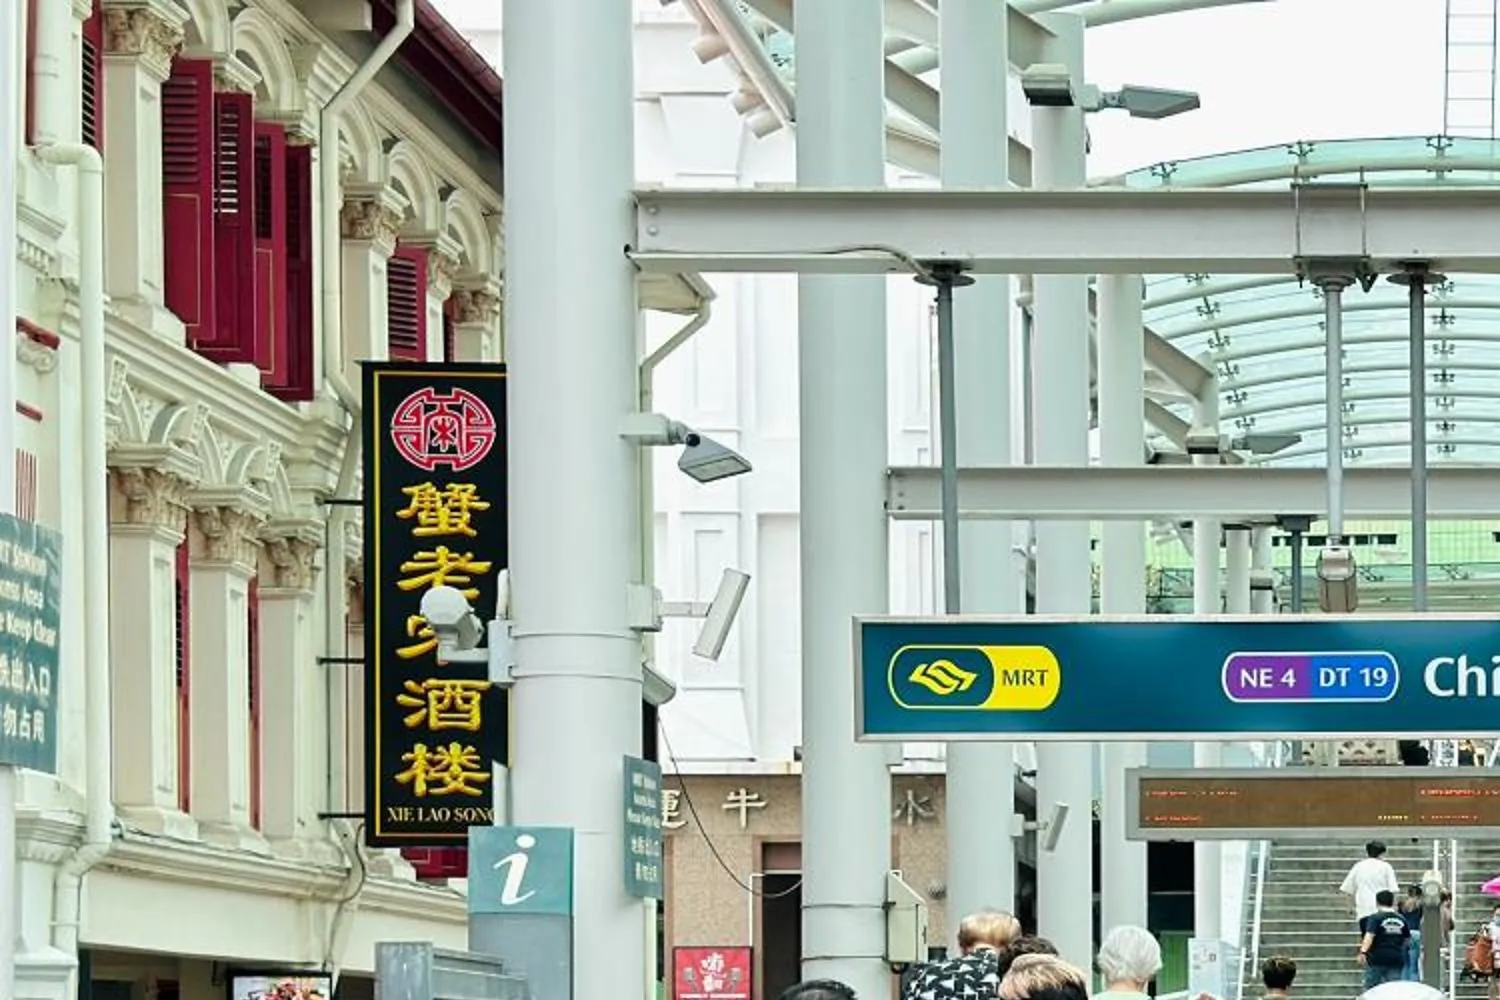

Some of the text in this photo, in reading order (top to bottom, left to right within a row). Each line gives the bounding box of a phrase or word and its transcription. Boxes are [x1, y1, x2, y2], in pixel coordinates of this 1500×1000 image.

[395, 480, 493, 798] 蟹老酒楼
[1001, 668, 1050, 687] MRT
[1240, 666, 1389, 688] NE 4 DT 19
[387, 806, 415, 823] XIE
[417, 806, 451, 823] LAO
